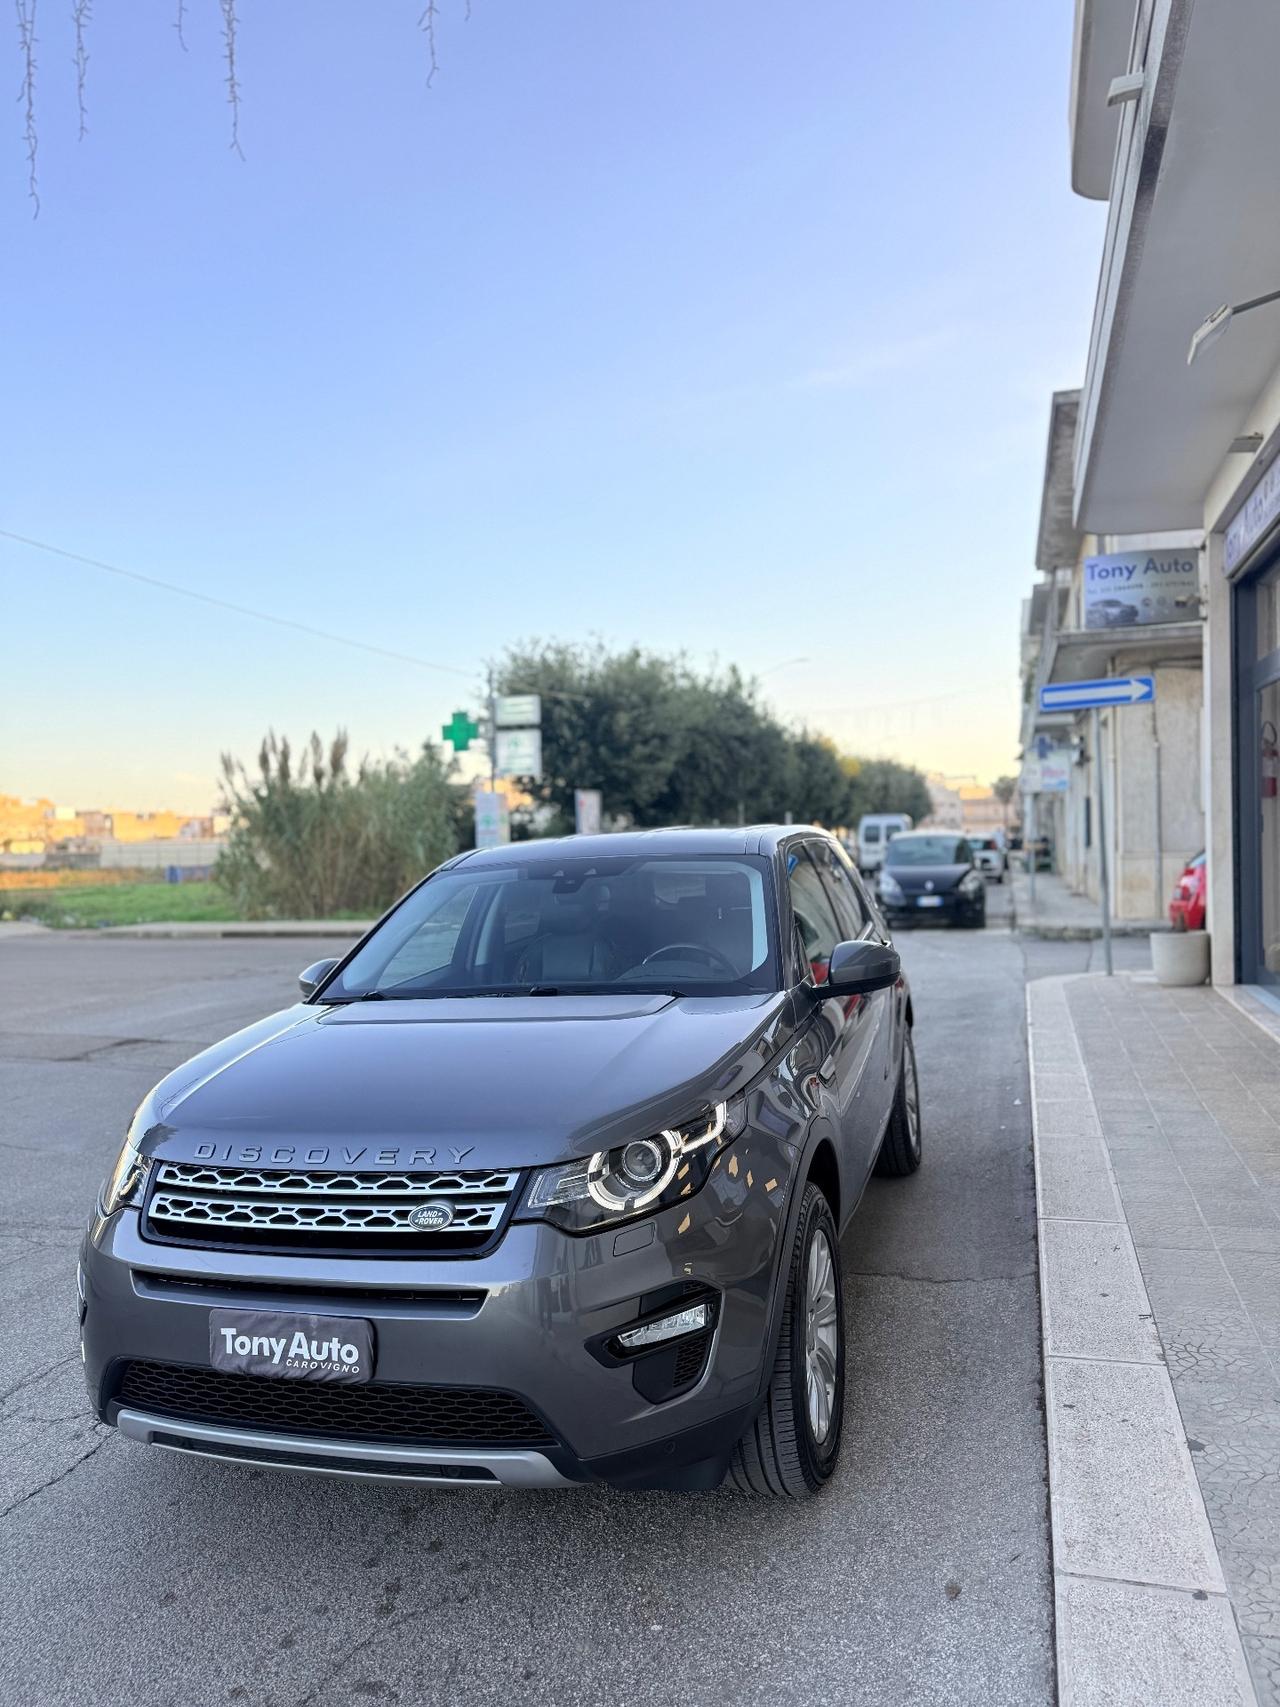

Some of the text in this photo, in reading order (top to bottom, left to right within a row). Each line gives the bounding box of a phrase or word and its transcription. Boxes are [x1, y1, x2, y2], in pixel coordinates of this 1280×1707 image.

[1087, 558, 1194, 581] Tony Auto
[193, 1142, 476, 1166] DISCOVERY
[417, 1210, 438, 1218] LAND
[418, 1217, 444, 1225] ROVER
[286, 1359, 360, 1374] CAROVIGNO
